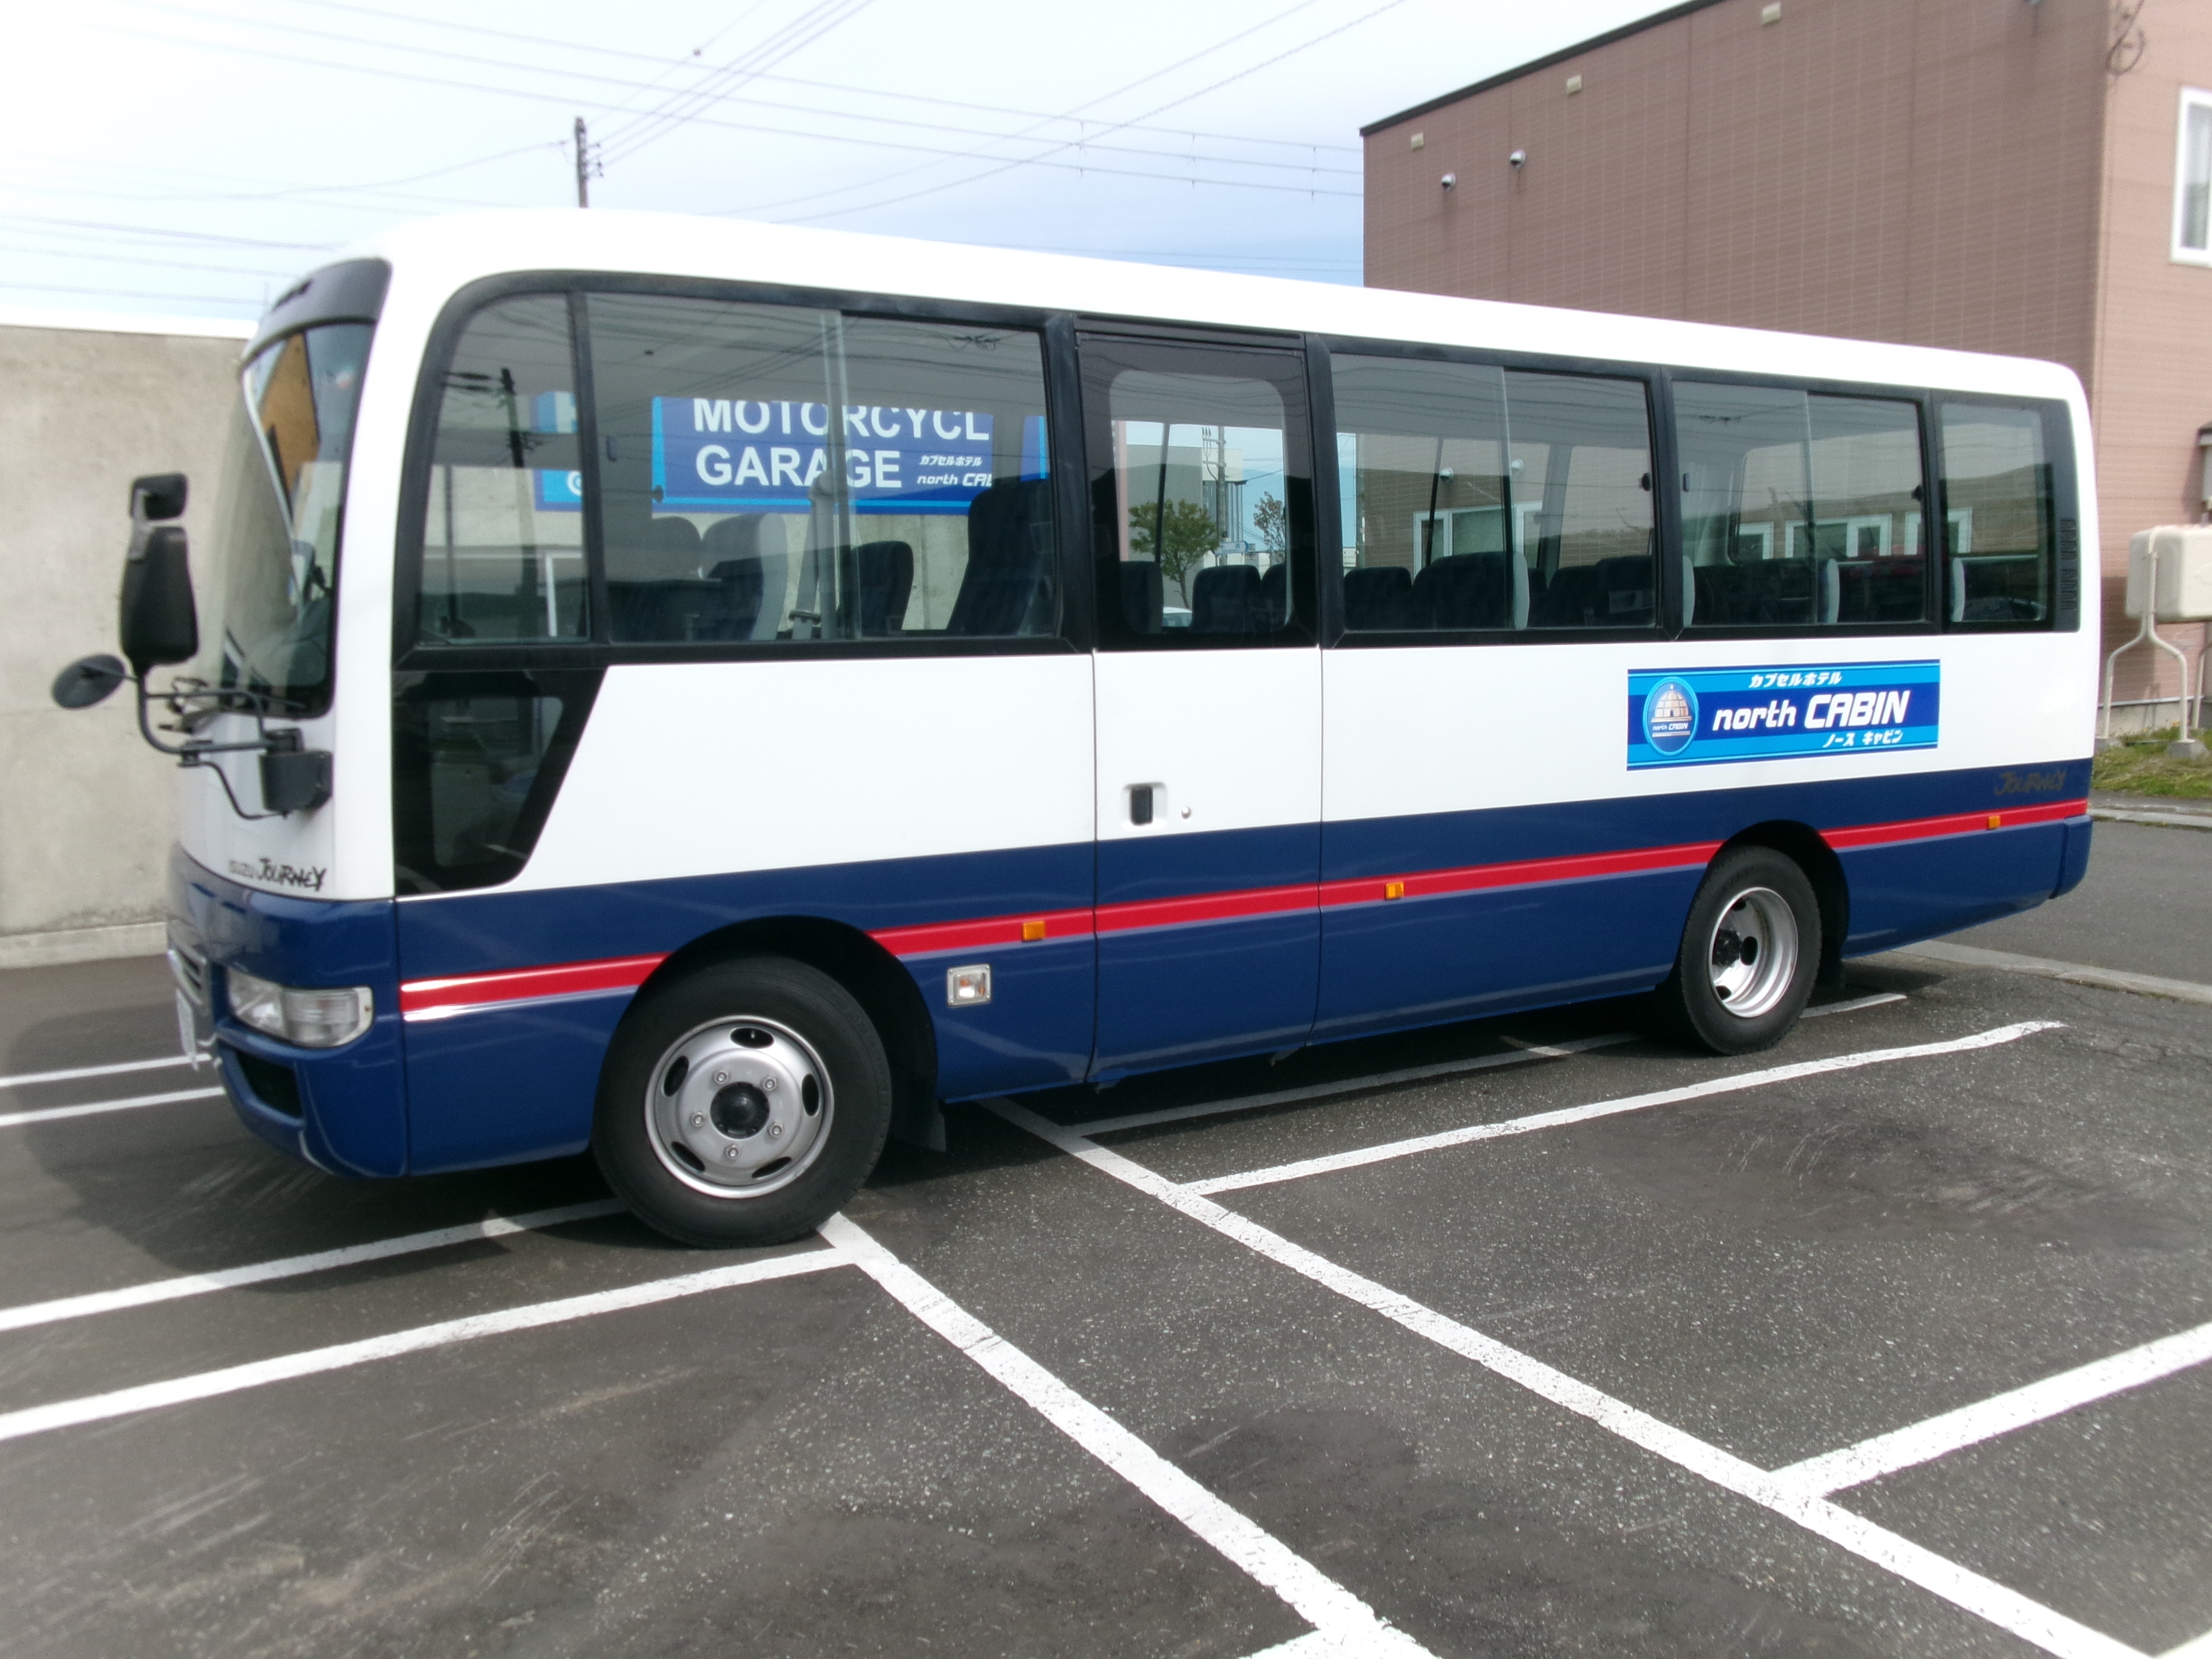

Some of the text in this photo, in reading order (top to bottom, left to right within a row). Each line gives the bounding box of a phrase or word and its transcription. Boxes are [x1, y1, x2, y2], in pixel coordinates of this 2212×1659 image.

[696, 445, 902, 488] GARAGE
[917, 474, 959, 485] north
[1712, 690, 1911, 731] north CABIN
[1822, 729, 1903, 748] ノース キャビン
